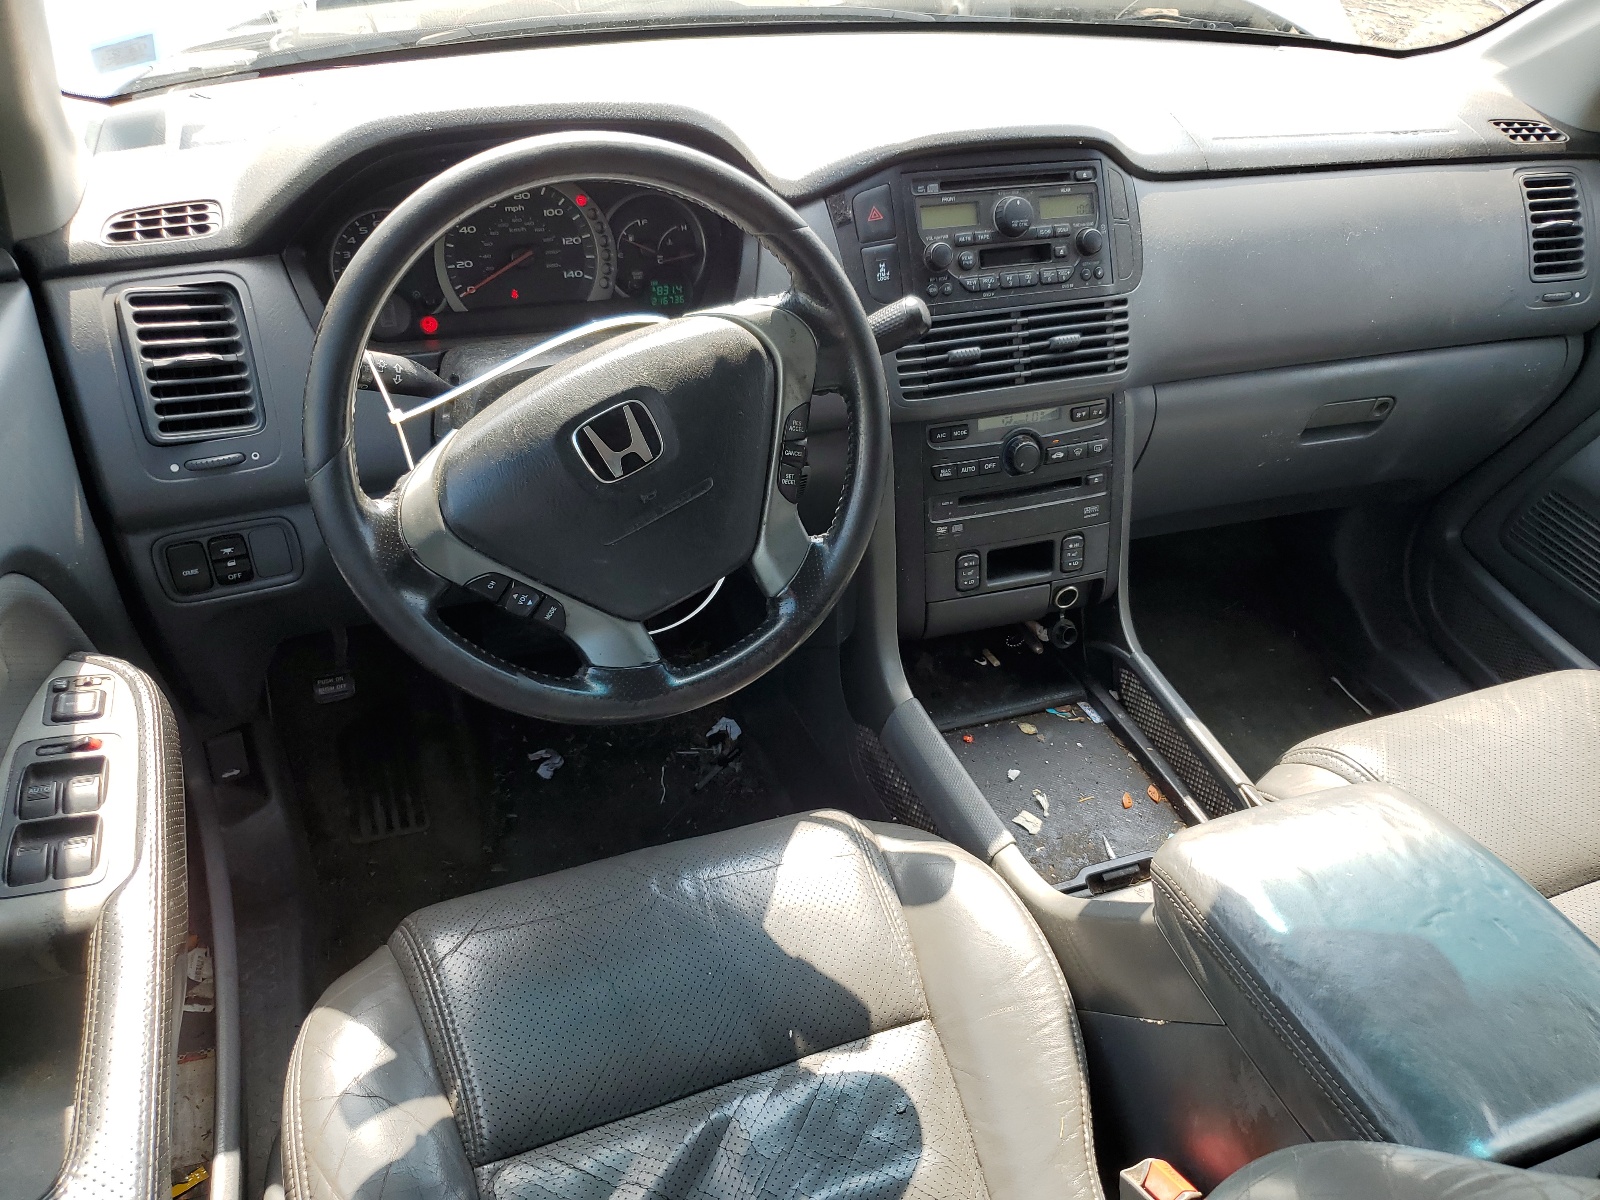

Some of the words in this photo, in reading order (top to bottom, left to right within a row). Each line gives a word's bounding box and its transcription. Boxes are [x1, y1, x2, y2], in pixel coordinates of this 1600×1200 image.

[504, 204, 525, 212] mph
[543, 208, 564, 217] 100
[358, 226, 369, 235] 5
[459, 225, 477, 235] 40
[346, 236, 357, 245] 4
[562, 236, 582, 246] 120
[341, 251, 351, 259] 3
[456, 260, 474, 269] 20
[563, 270, 584, 279] 140
[961, 465, 976, 473] AUTO
[984, 462, 997, 470] OFF
[227, 572, 243, 580] OFF
[487, 580, 497, 589] CH
[518, 594, 528, 605] VOL
[544, 606, 557, 621] MODE
[28, 786, 51, 795] AUTO
